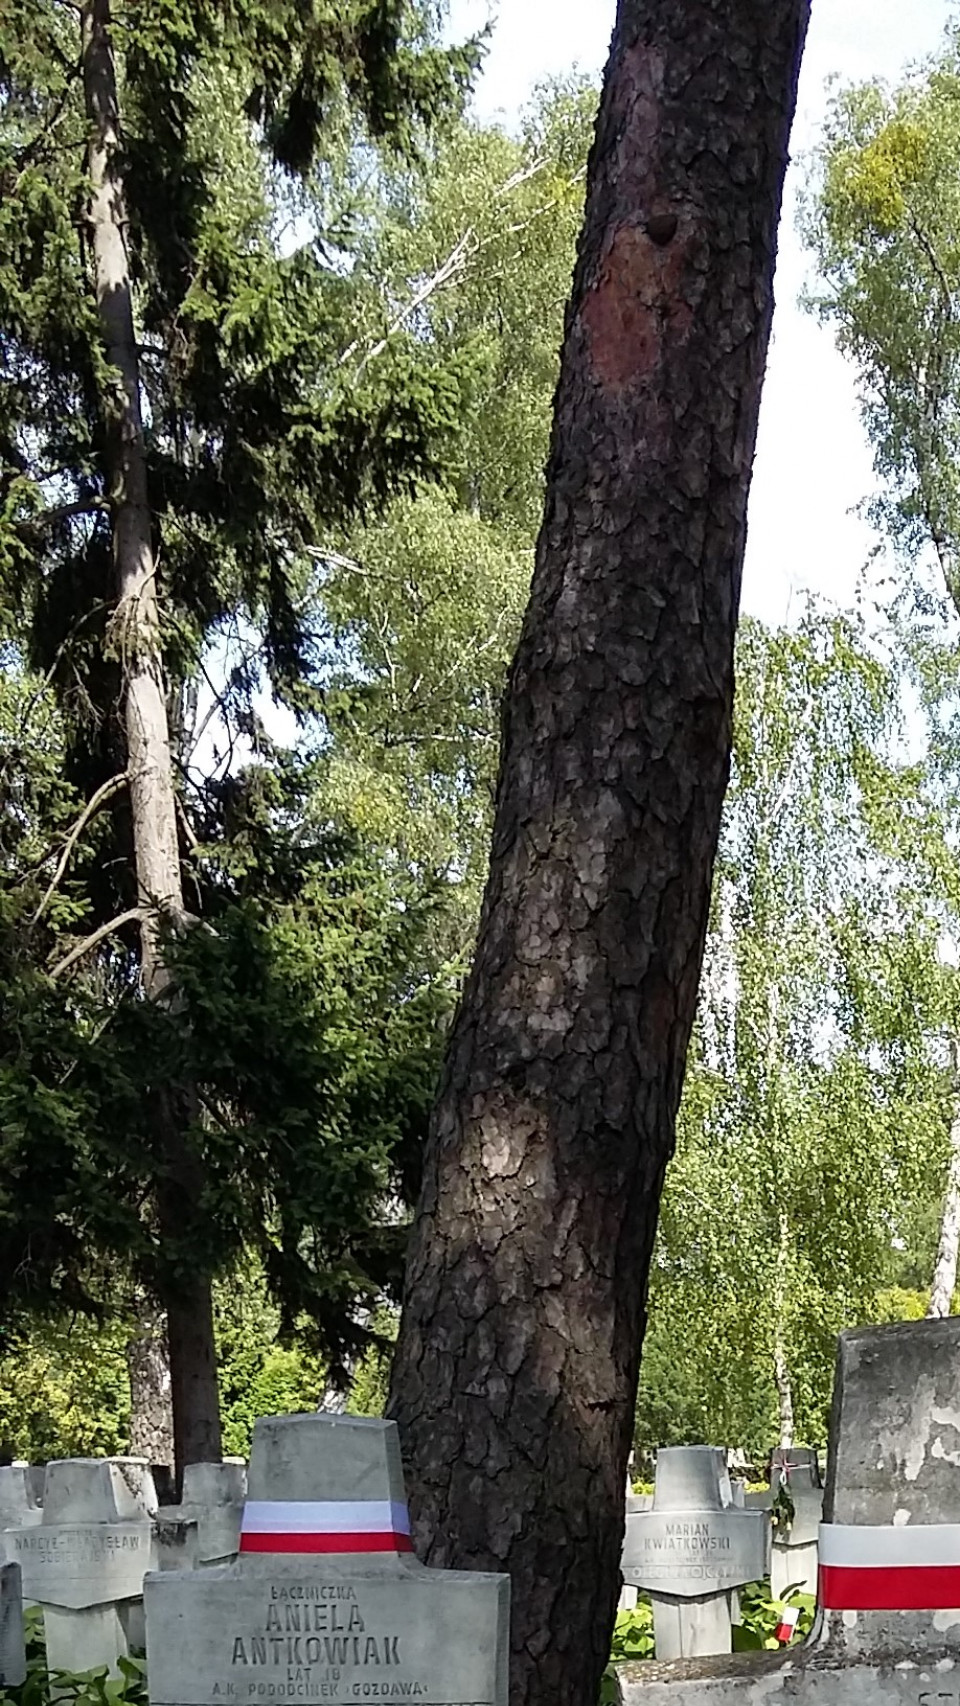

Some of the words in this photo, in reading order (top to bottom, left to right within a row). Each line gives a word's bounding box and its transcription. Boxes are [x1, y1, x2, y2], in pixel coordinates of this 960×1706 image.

[665, 1524, 709, 1535] MARIAN
[266, 1604, 365, 1632] ANIELA
[232, 1636, 401, 1665] ANTKOWIAK
[287, 1668, 312, 1681] LAT
